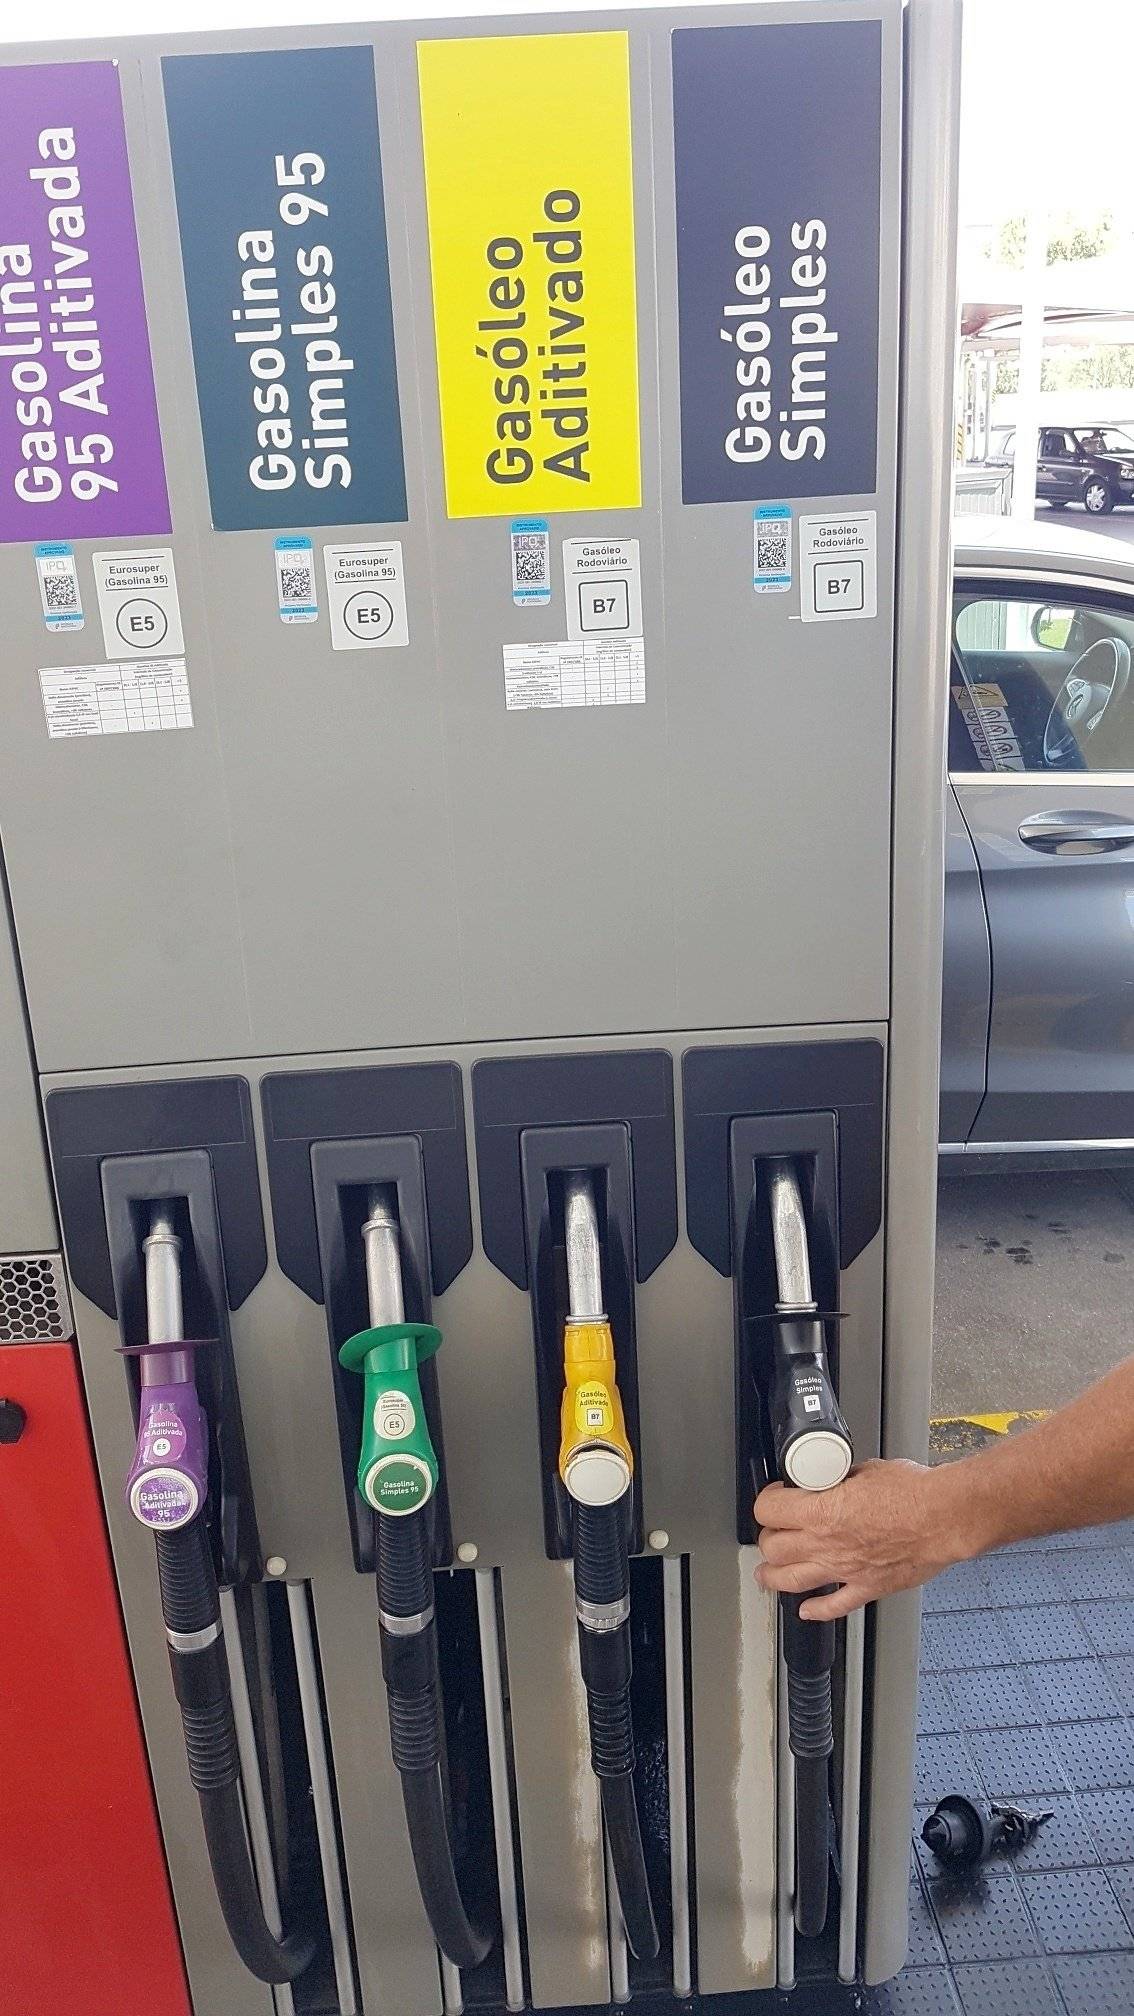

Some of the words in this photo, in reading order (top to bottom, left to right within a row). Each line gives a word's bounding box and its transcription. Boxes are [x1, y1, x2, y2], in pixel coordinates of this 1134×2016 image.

[274, 152, 329, 226] 95
[29, 125, 109, 416] Aditivada
[532, 189, 591, 483] Aditivado
[779, 219, 839, 461] Simples
[720, 225, 772, 463] Gasóleo
[231, 230, 297, 491] Gasolina
[475, 237, 534, 485] Gasóleo
[290, 245, 354, 489] Simples
[0, 243, 63, 503] Gasolina
[64, 433, 119, 501] 95
[819, 527, 858, 536] Gasóleo
[813, 537, 864, 548] Rodoviário
[582, 546, 621, 556] Gasóleo
[339, 557, 388, 567] Eurosuper
[577, 557, 628, 567] Rodoviário
[109, 564, 160, 574] Eurosuper
[334, 569, 379, 580] (Gasolina
[381, 568, 396, 577] 95)
[104, 576, 150, 588] (Gasolina
[153, 574, 168, 585] 95)
[827, 579, 851, 594] B7
[593, 598, 616, 613] B7
[357, 608, 381, 624] E5
[130, 615, 155, 632] E5
[794, 1376, 822, 1386] Gasóleo
[580, 1391, 607, 1399] Gasóleo
[796, 1385, 823, 1394] Simples
[579, 1399, 609, 1407] Aditivado
[149, 1421, 178, 1429] Gasolina
[389, 1421, 400, 1429] E5
[151, 1428, 183, 1437] Aditivada
[383, 1481, 415, 1489] Gasolina
[140, 1489, 183, 1501] Gasolina
[380, 1487, 409, 1496] Simples
[410, 1486, 419, 1494] 95
[143, 1500, 186, 1509] Aditivada
[157, 1509, 170, 1518] 95
